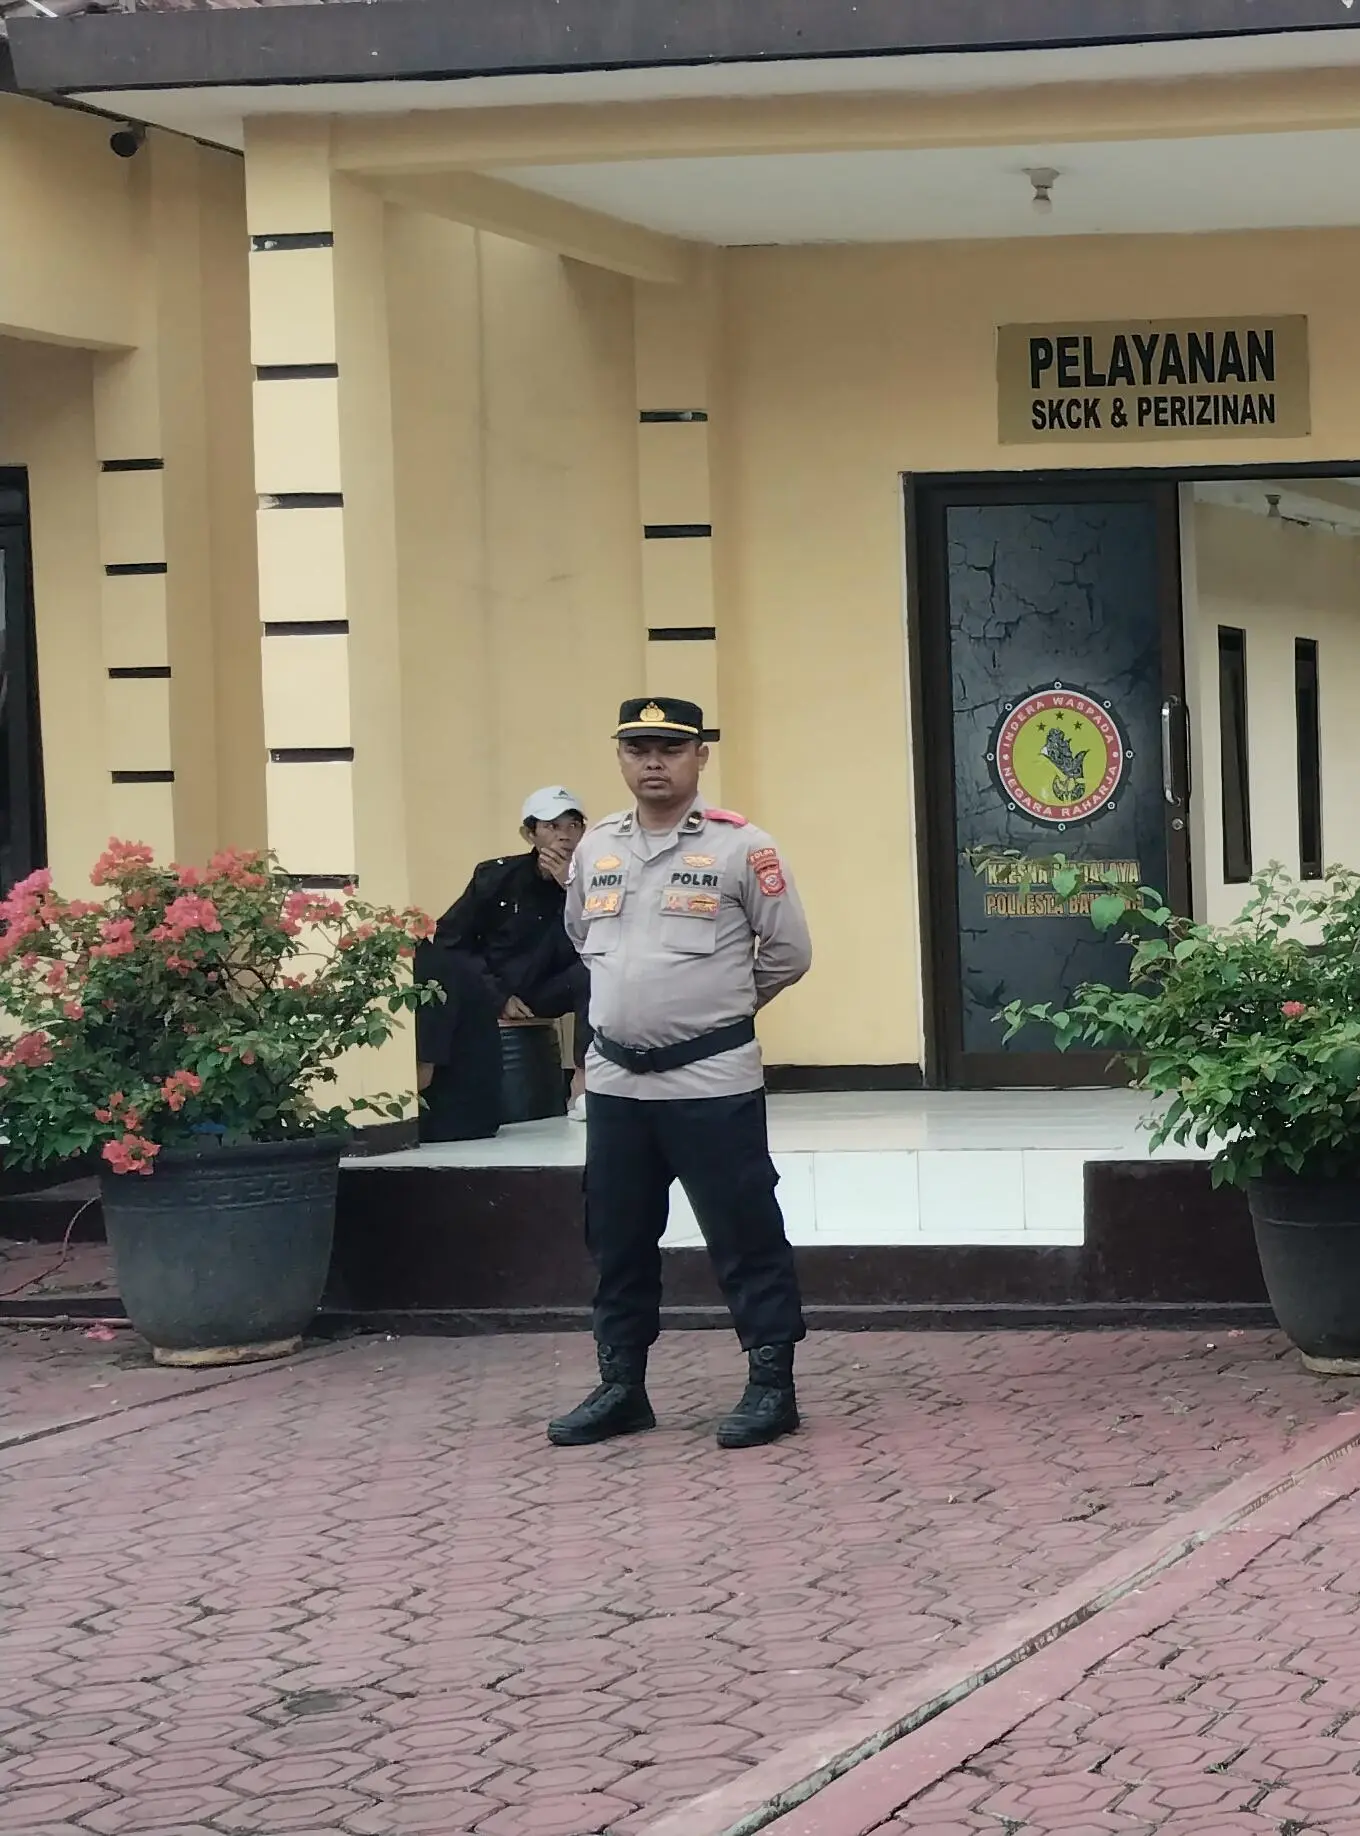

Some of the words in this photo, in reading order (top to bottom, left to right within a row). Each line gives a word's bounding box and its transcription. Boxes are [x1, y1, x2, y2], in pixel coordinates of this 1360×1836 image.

[1029, 329, 1276, 389] PELAYANAN
[1031, 398, 1102, 430] SKCK
[1111, 397, 1129, 428] &
[1137, 393, 1276, 427] PERIZINAN
[1003, 701, 1045, 748] INDERA
[1053, 697, 1114, 744] WASPADA
[1002, 767, 1053, 817] NEGARA
[1061, 765, 1118, 817] RAHARJA
[591, 874, 623, 888] ANDI
[671, 872, 719, 887] POLRI
